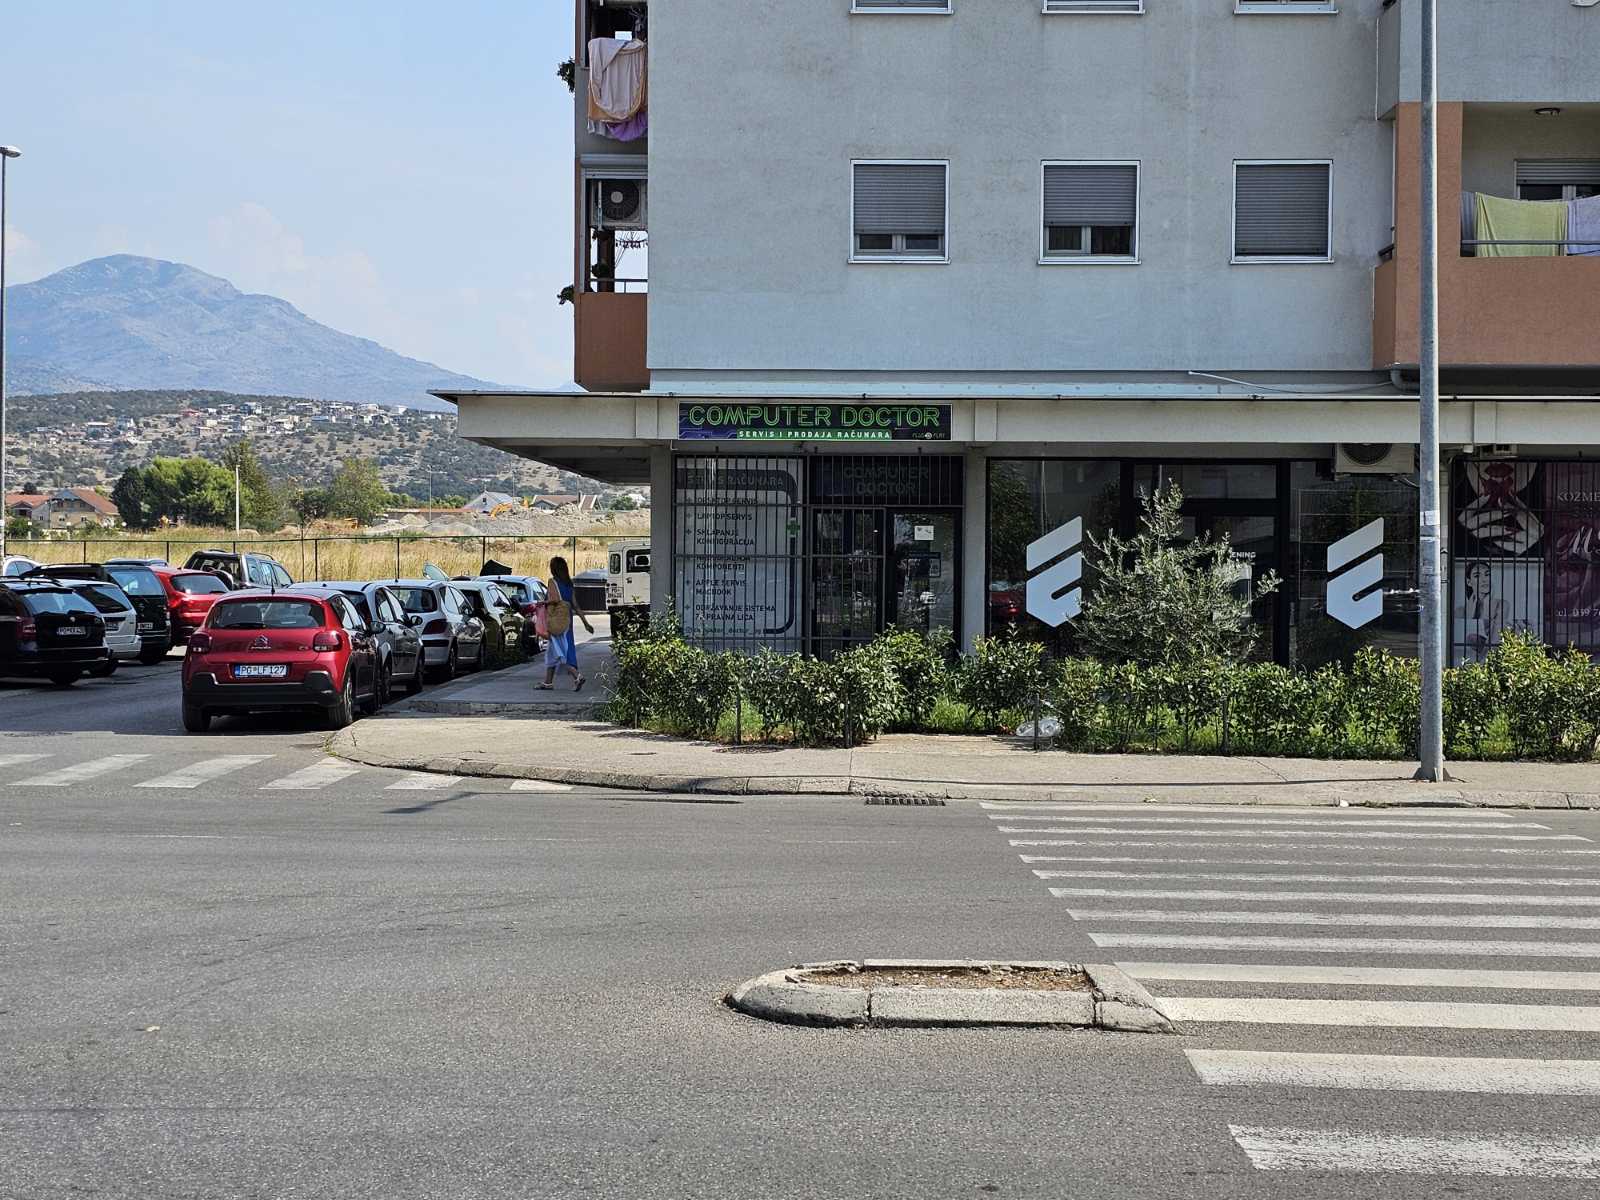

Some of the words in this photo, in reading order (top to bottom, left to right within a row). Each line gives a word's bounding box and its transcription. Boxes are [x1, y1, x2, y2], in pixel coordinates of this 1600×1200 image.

[689, 406, 832, 426] COMPUTER
[841, 406, 940, 426] DOCTOR
[739, 431, 775, 439] SERVIS
[788, 431, 832, 439] PRODAJA
[837, 429, 890, 439] RAČUNARA
[844, 466, 929, 479] COMPUTER
[856, 482, 916, 495] DOCTOR
[241, 666, 252, 675] PG
